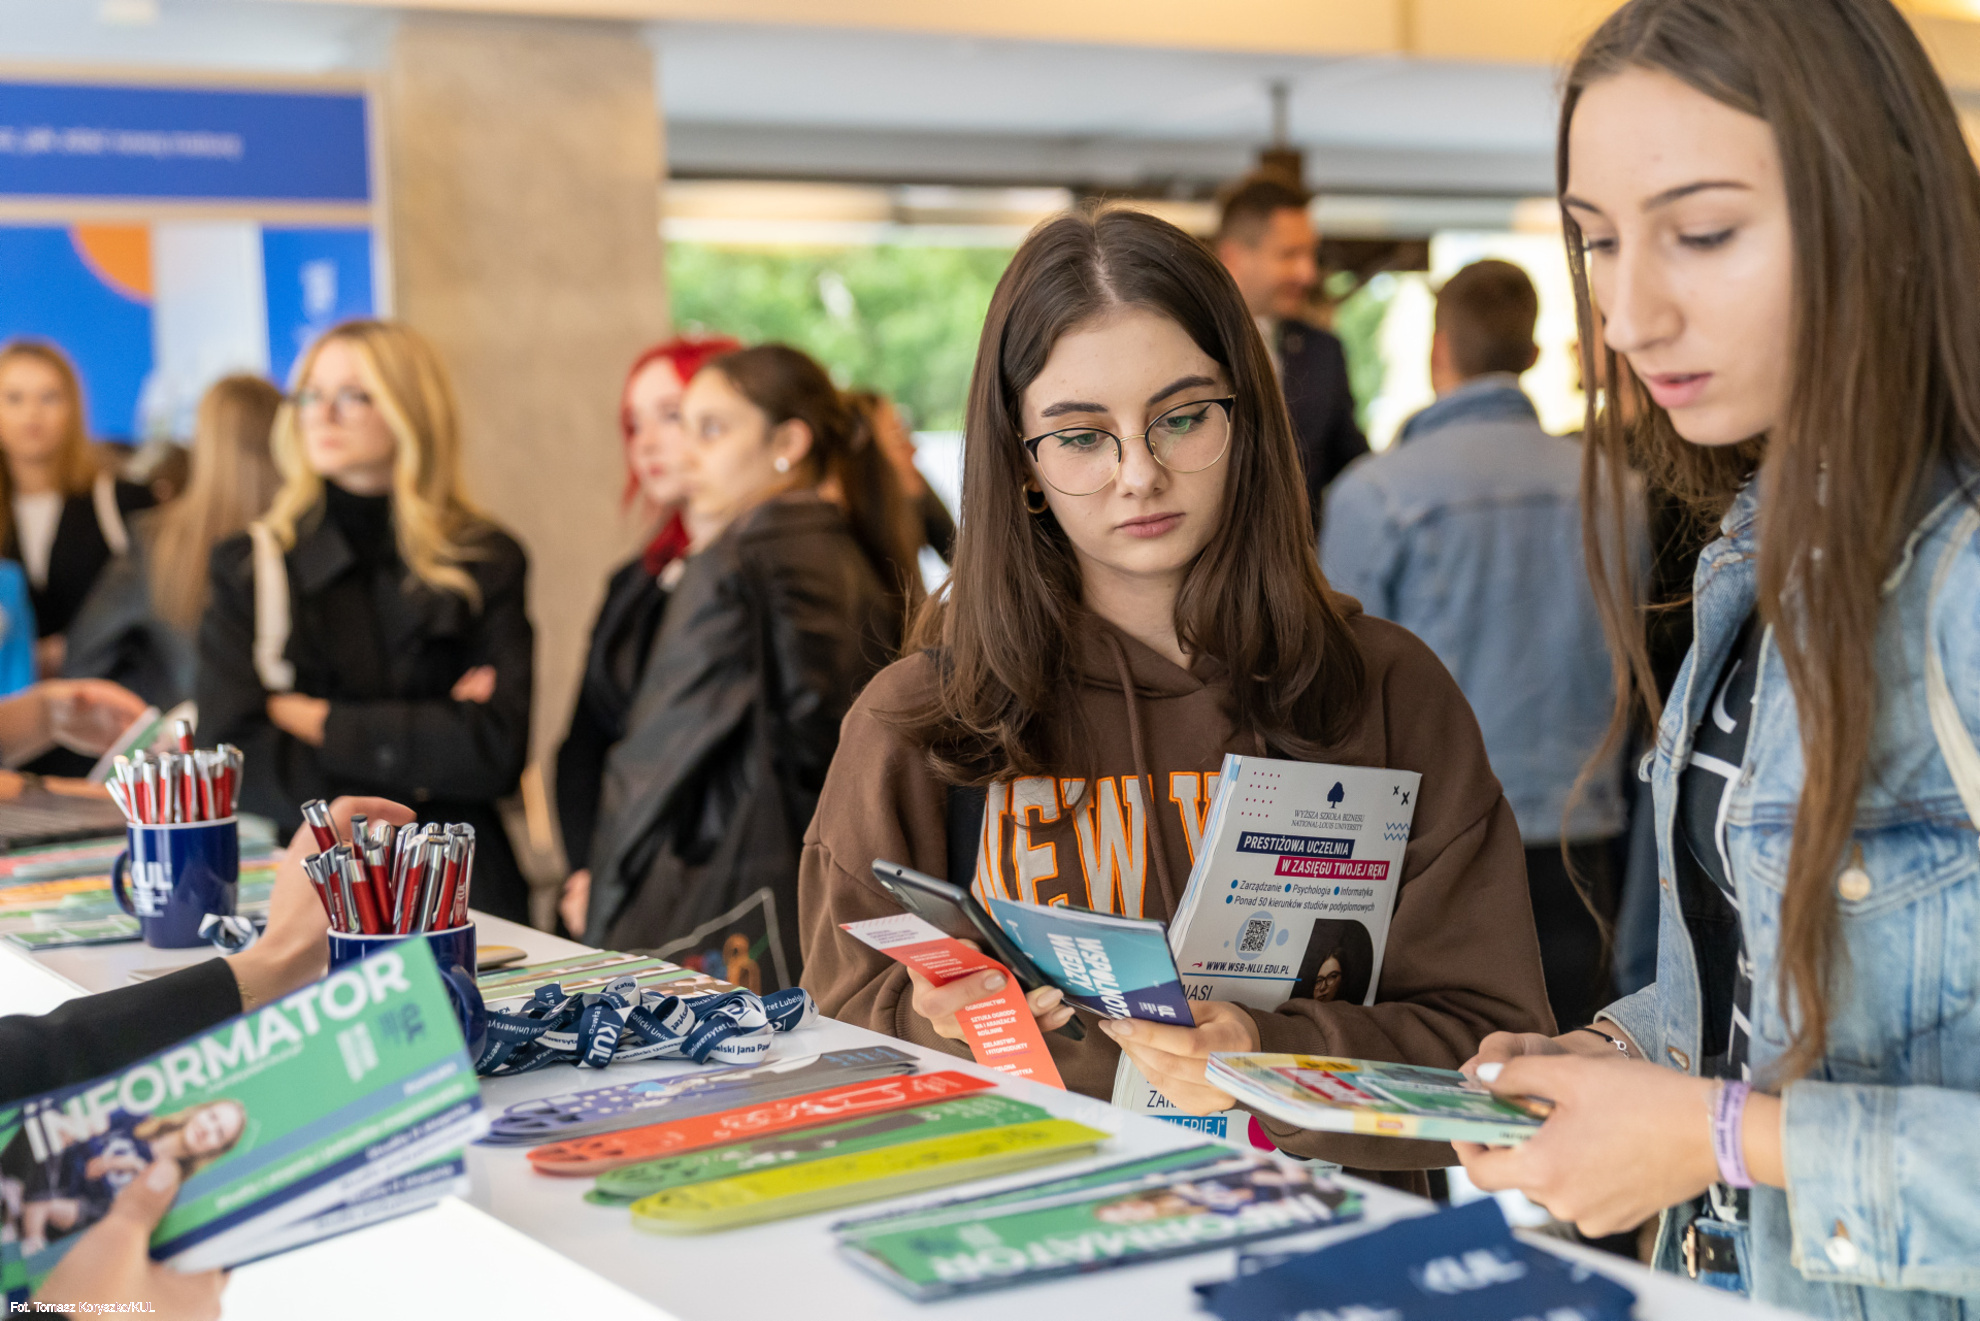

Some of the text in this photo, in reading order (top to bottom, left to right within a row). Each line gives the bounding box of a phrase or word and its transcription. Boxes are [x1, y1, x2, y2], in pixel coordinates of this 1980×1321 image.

[1294, 810, 1365, 822] WYŻSZA SZKOŁA BIZNESU
[1291, 820, 1363, 831] NATIONAL-LOUIS UNIVERSITY
[1244, 836, 1349, 855] PRESTIŻOWA UCZELNIA
[1281, 859, 1386, 880] W ZASIĘGU TWOJEJ RĘKI
[1239, 880, 1373, 897] Zarządzanie Psychologia Informatyka
[1234, 896, 1375, 913] Ponad 50 kierunków studiów podyplomowych
[1206, 961, 1290, 975] WWW.WSB-NLU.EDU.PL
[965, 998, 1006, 1011] OGRODNICTWO
[970, 1009, 1016, 1023] SZTUKA OGRODO-
[977, 1026, 1003, 1037] ROŚLINNE
[588, 1025, 618, 1060] KUL
[737, 1043, 756, 1055] Jana
[982, 1037, 1016, 1049] ZIELARSTWO
[988, 1043, 1028, 1055] FITOPRODUKTY
[22, 949, 410, 1164] INFORMATOR
